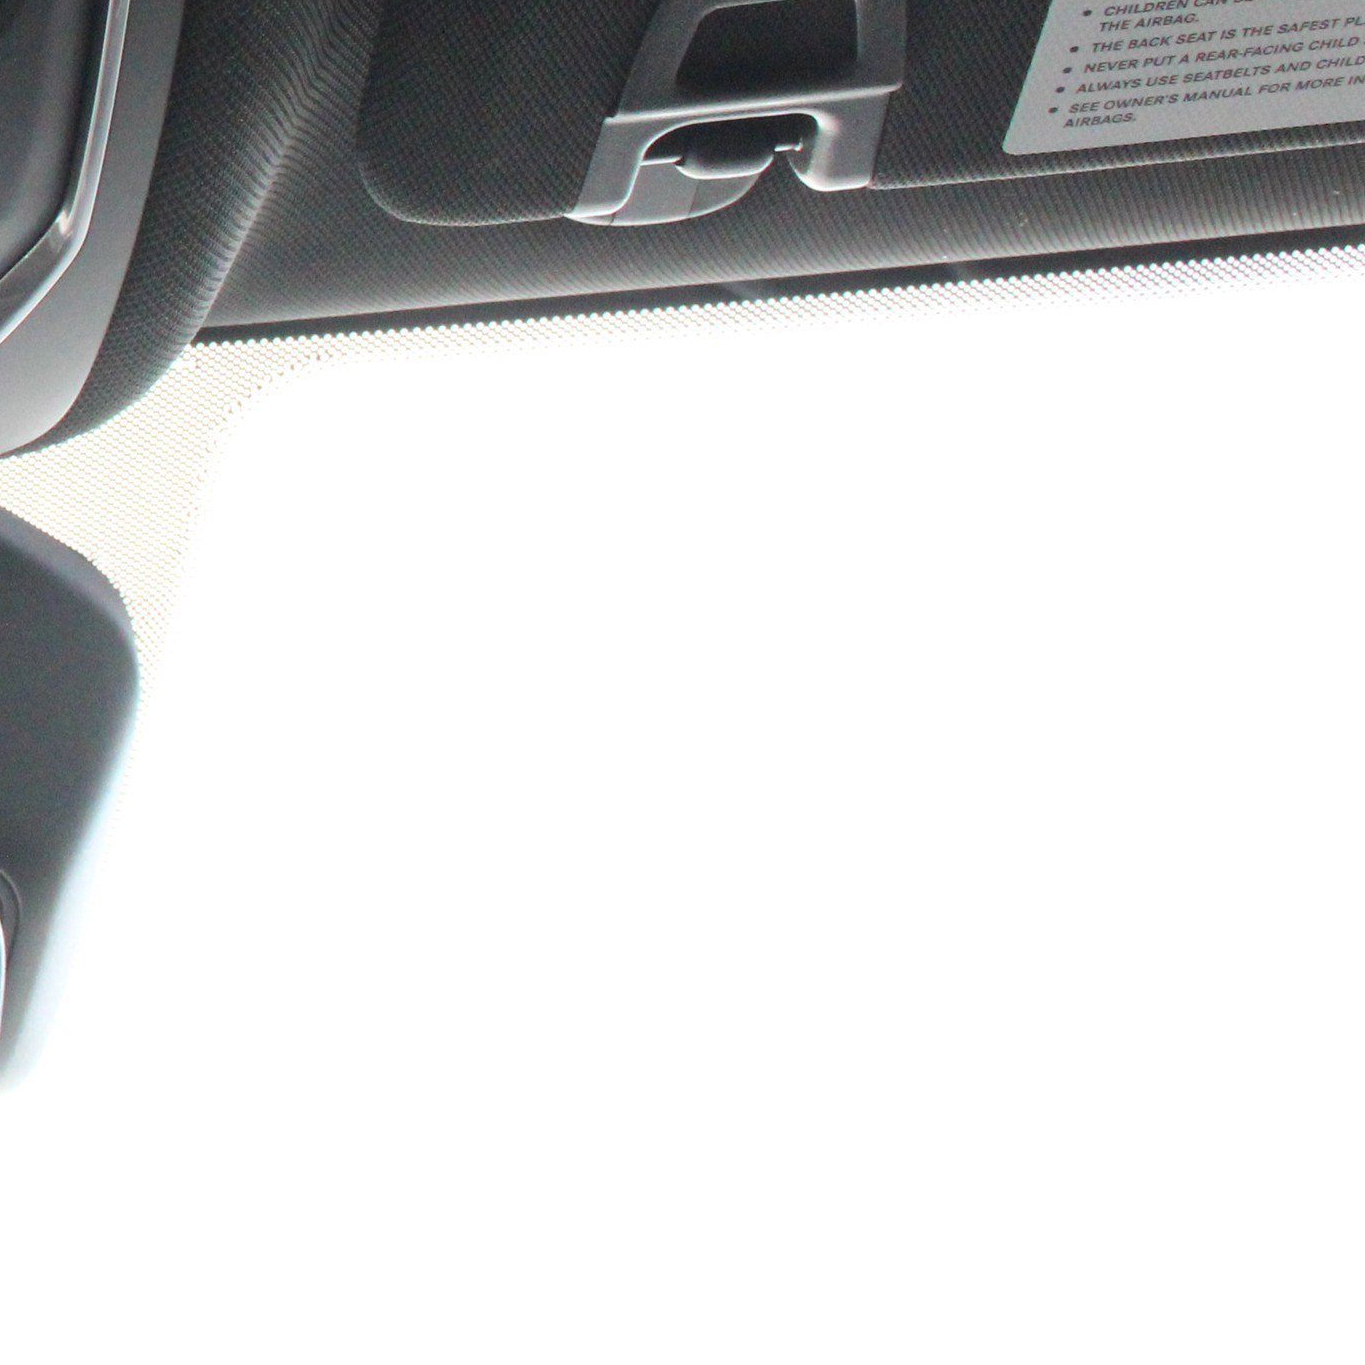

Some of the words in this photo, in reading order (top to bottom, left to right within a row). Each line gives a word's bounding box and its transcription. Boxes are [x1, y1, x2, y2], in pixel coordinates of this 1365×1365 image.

[1092, 40, 1124, 53] THE
[1128, 37, 1170, 50] BACK
[1175, 30, 1217, 45] SEAT
[1220, 29, 1236, 40] IS
[1242, 25, 1273, 36] THE
[1277, 18, 1340, 34] SAFEST
[1100, 19, 1131, 32] THE
[1134, 13, 1199, 29] AIRBAG.
[1084, 59, 1139, 73] NEVER
[1143, 55, 1176, 67] PUT
[1178, 54, 1190, 65] A
[1195, 42, 1304, 62] REAR-FACING
[1308, 36, 1359, 49] CHILD
[1076, 78, 1141, 94] ALWAYS
[1146, 74, 1179, 86] USE
[1182, 65, 1271, 83] SEATBELTS
[1274, 61, 1311, 73] AND
[1316, 55, 1365, 69] CHILD
[1068, 101, 1100, 114] SEE
[1103, 93, 1179, 111] OWNER'S
[1183, 85, 1253, 102] MANUAL
[1258, 82, 1291, 94] FOR
[1295, 76, 1345, 90] MORE
[1063, 112, 1136, 128] AIRBAGS.
